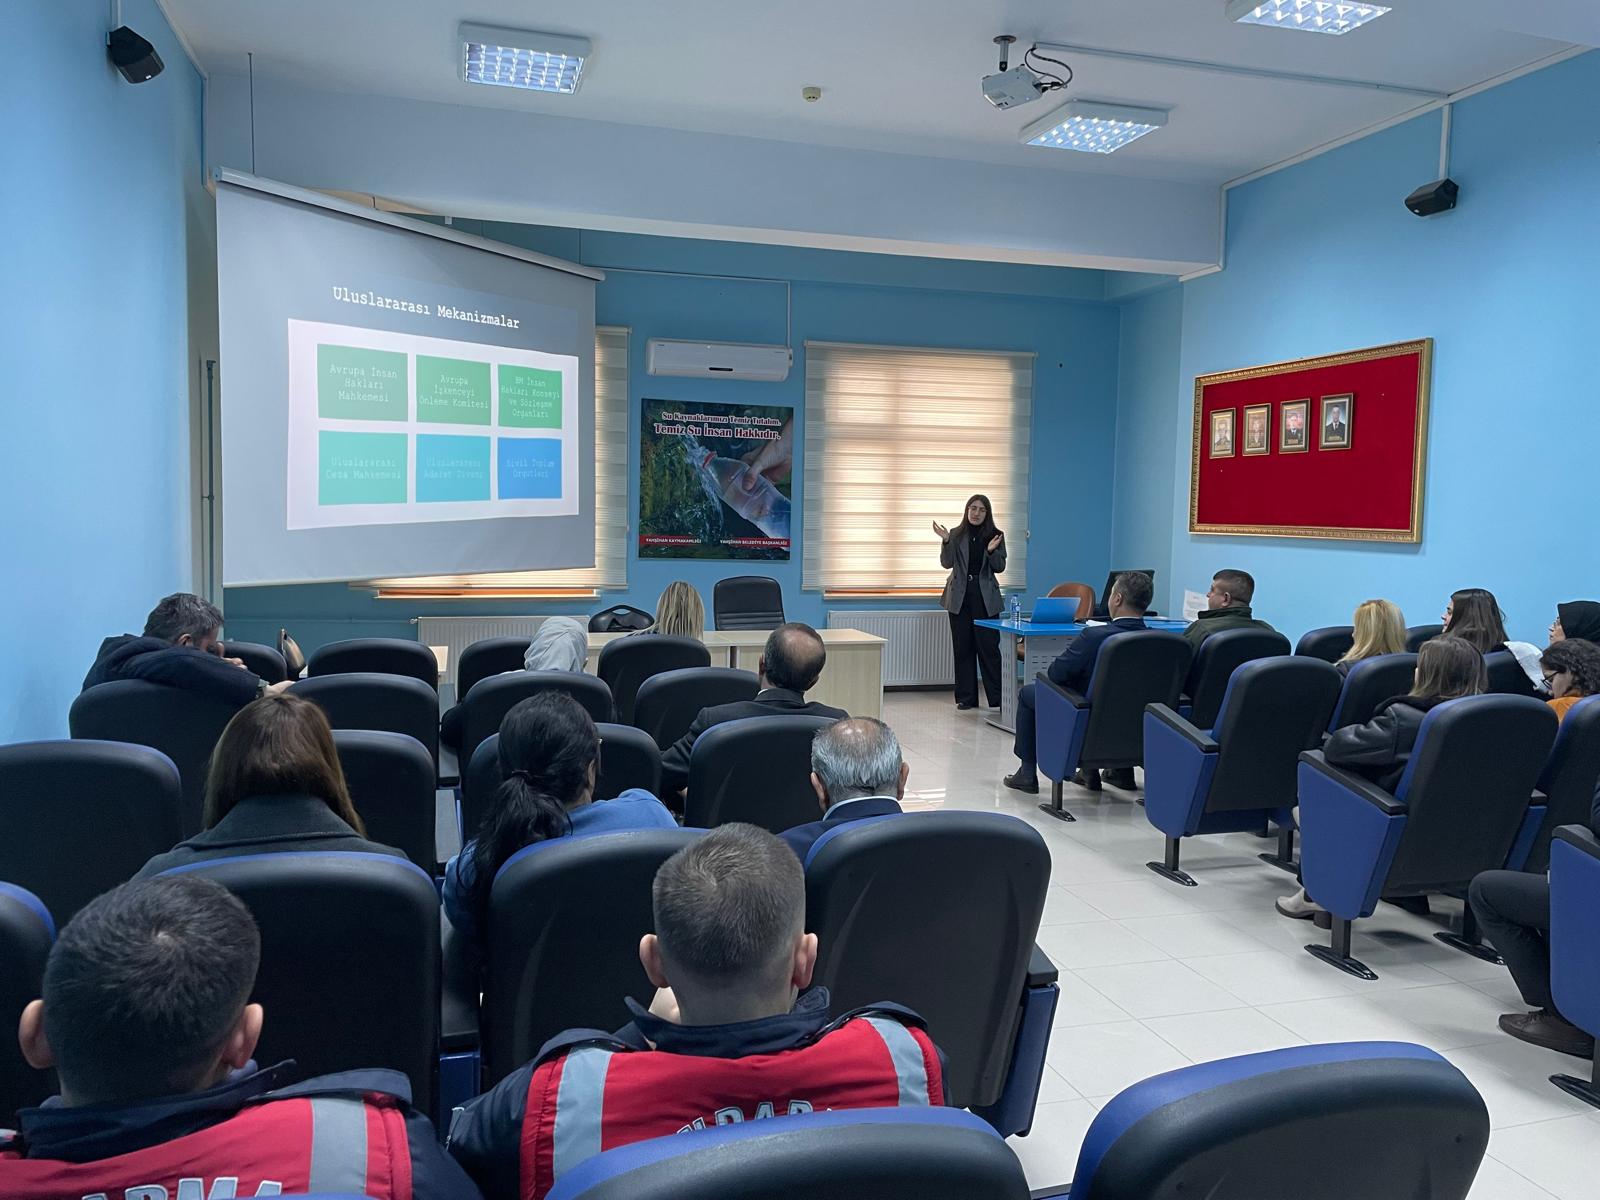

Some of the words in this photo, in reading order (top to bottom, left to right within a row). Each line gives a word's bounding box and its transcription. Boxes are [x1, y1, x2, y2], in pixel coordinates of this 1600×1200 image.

[333, 286, 431, 315] Uluslararası
[437, 304, 520, 329] Mekanizmalar
[329, 363, 365, 377] Avrupa
[371, 365, 397, 379] İnsan
[345, 377, 383, 389] Hakları
[440, 374, 468, 386] Avrupa
[338, 390, 389, 402] Mahkemesi
[452, 398, 489, 409] Komitesi
[511, 408, 549, 419] Organları
[662, 412, 673, 420] Su
[674, 412, 728, 423] Kaynaklarımızı
[729, 416, 751, 425] Temiz
[654, 423, 685, 434] Temiz
[687, 425, 701, 436] Su
[703, 423, 732, 438] İnsan
[735, 428, 781, 440] Hakkıdır.
